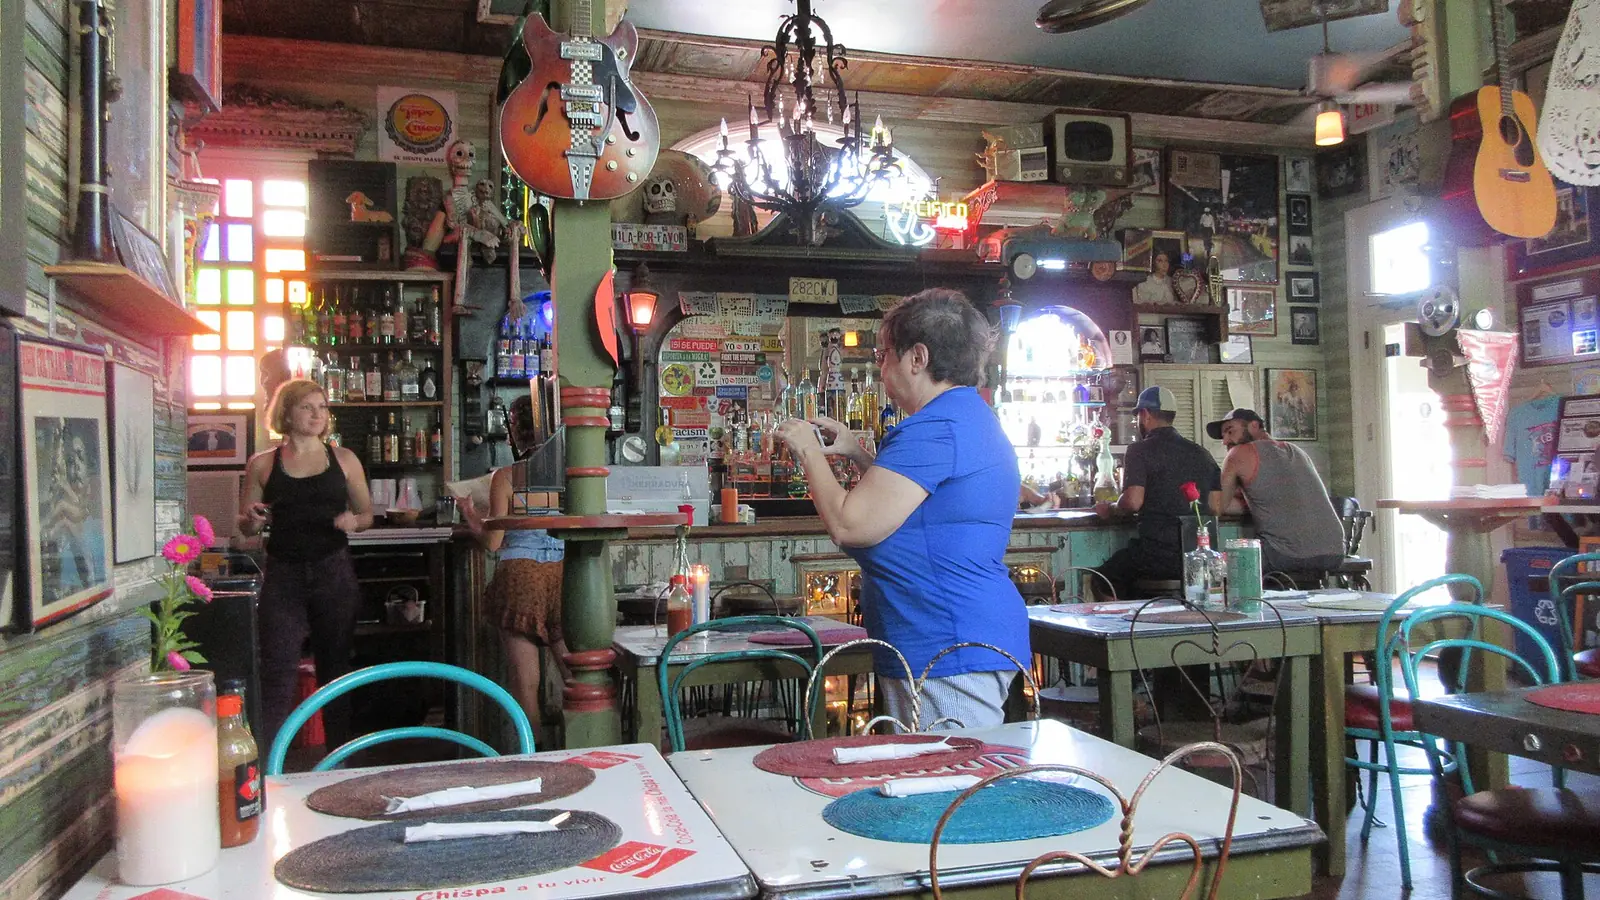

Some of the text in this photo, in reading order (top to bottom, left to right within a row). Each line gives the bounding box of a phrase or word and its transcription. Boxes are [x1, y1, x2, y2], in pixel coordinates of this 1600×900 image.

[744, 343, 759, 351] D.F.
[735, 377, 759, 385] TORTILLAS
[416, 886, 506, 900] Chispa
[564, 877, 606, 886] vivir
